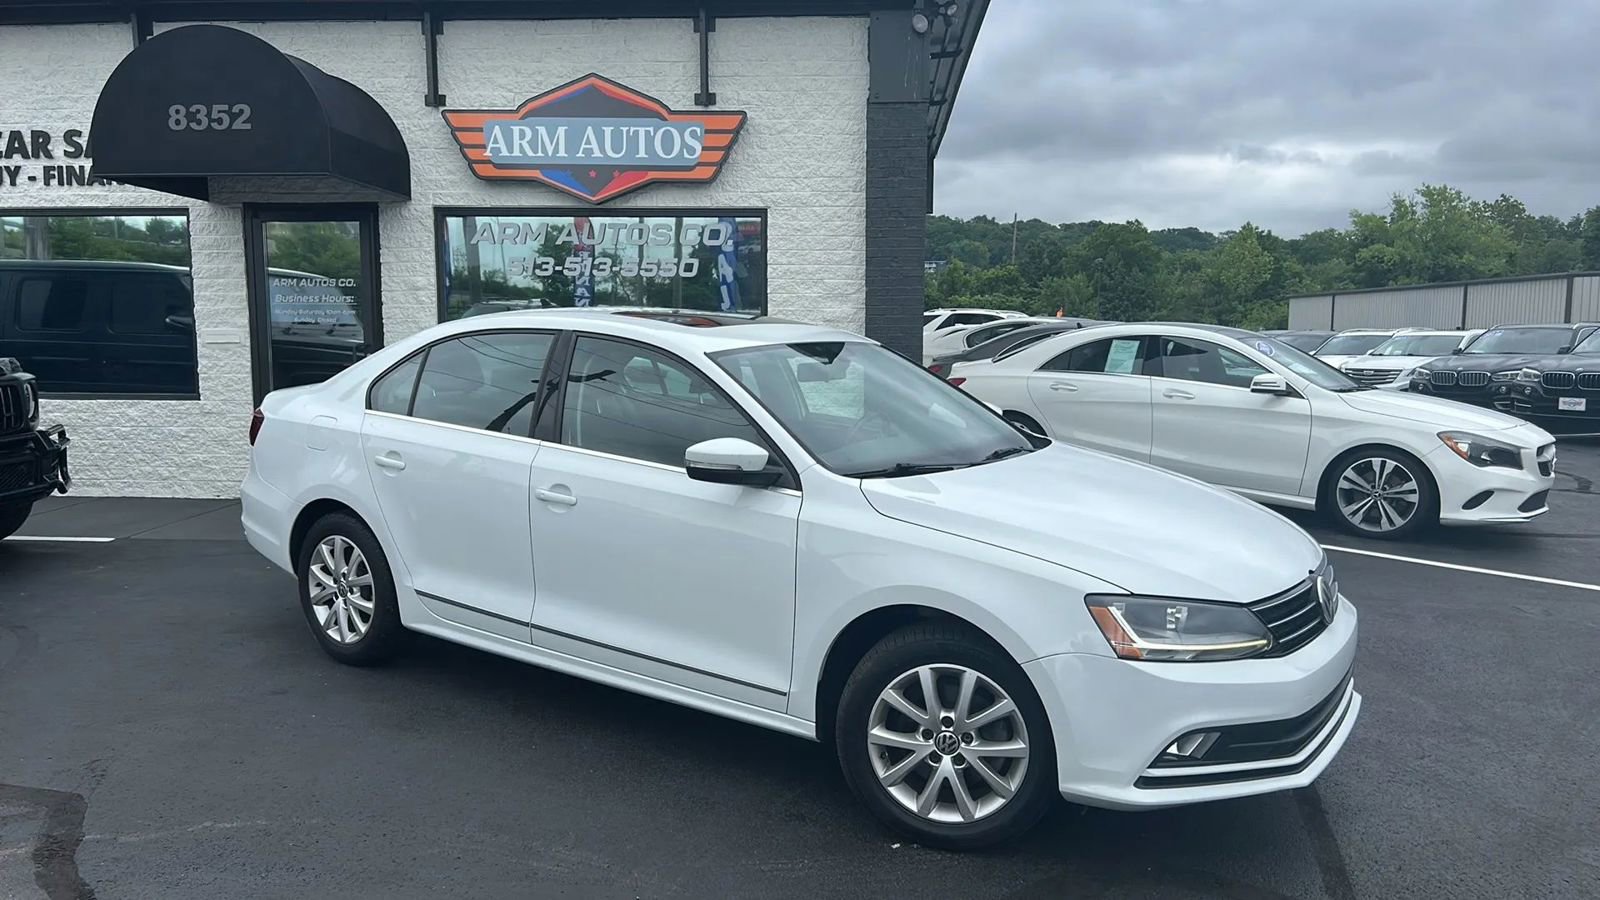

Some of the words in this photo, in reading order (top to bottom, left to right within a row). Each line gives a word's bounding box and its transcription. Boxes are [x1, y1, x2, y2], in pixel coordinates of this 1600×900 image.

[168, 103, 252, 131] 8352
[0, 130, 54, 159] AR
[483, 125, 568, 157] ARM
[576, 126, 703, 159] AUTOS
[470, 222, 549, 245] ARM
[555, 222, 673, 246] AUTOS
[679, 222, 734, 247] CO.
[507, 256, 700, 278] 513-513-5550
[273, 278, 297, 287] ARM
[299, 278, 337, 287] AUTOS
[338, 278, 357, 287] CO.
[275, 294, 320, 303] Business
[321, 294, 355, 303] Hours:
